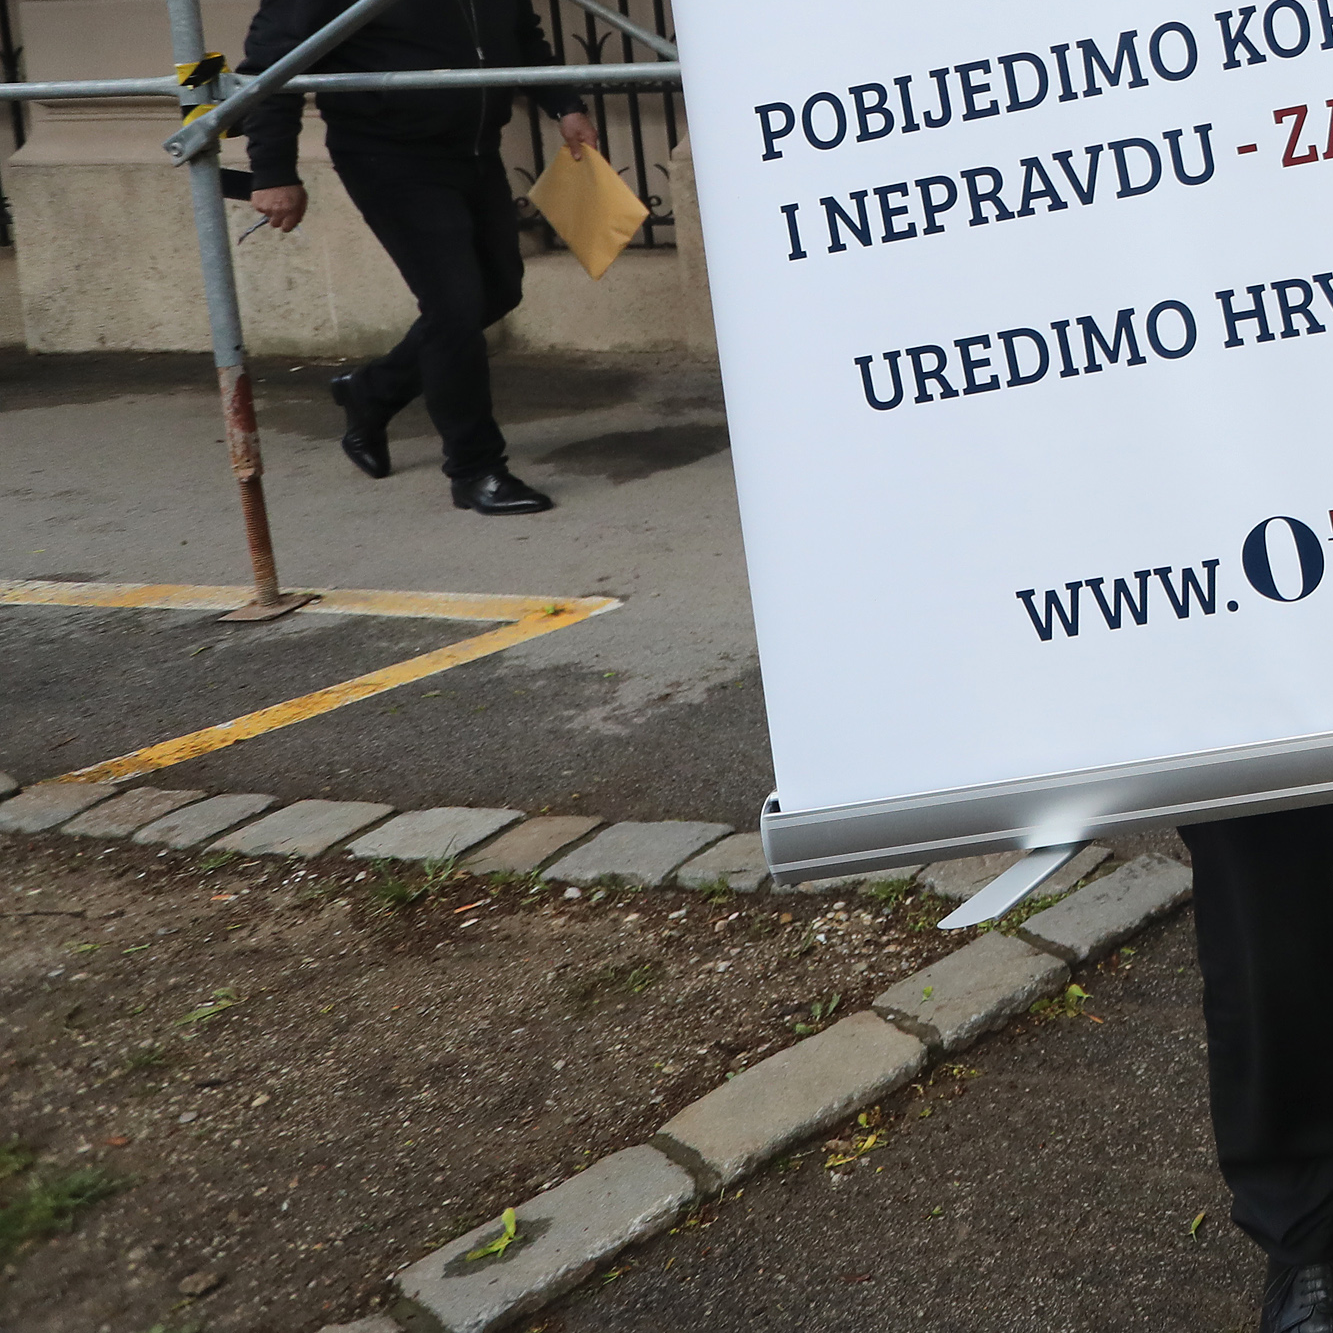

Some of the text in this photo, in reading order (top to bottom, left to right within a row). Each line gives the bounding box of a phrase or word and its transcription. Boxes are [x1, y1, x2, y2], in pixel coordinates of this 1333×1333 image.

[754, 21, 1199, 162] POBIJEDIMO
[780, 202, 808, 262] I
[820, 122, 1216, 254] NEPRAVDU
[1236, 142, 1258, 155] -
[853, 299, 1198, 410] UREDIMO
